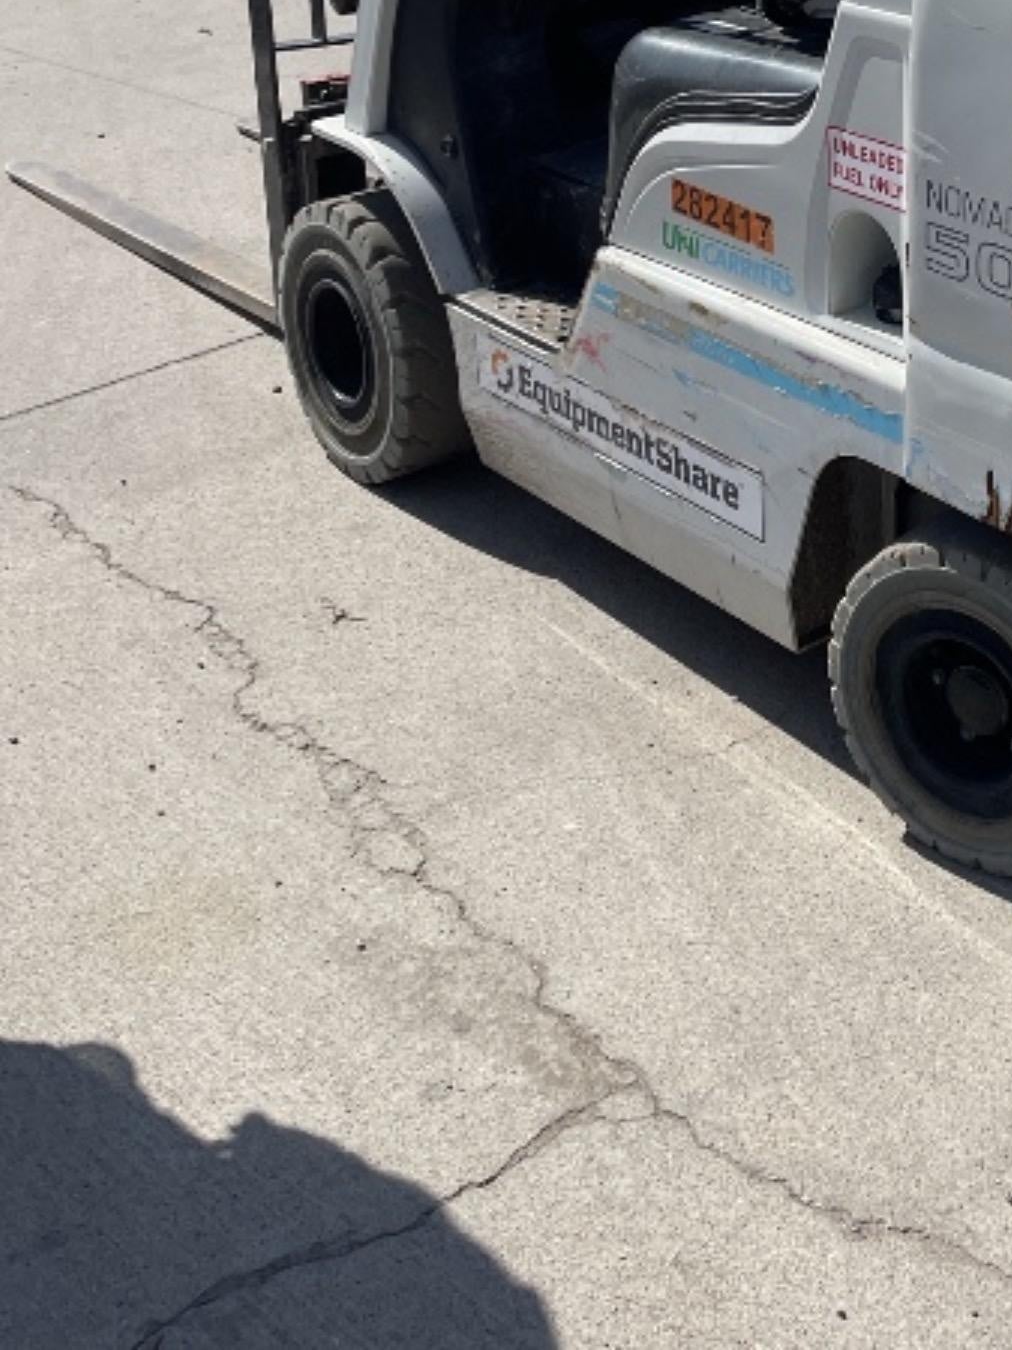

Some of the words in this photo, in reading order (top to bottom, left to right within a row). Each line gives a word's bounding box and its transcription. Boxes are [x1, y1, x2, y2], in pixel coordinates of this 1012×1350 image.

[833, 137, 904, 175] UNLEADED
[833, 161, 864, 187] FUEL
[671, 179, 774, 251] 282417
[518, 364, 740, 510] EquipmentShare
